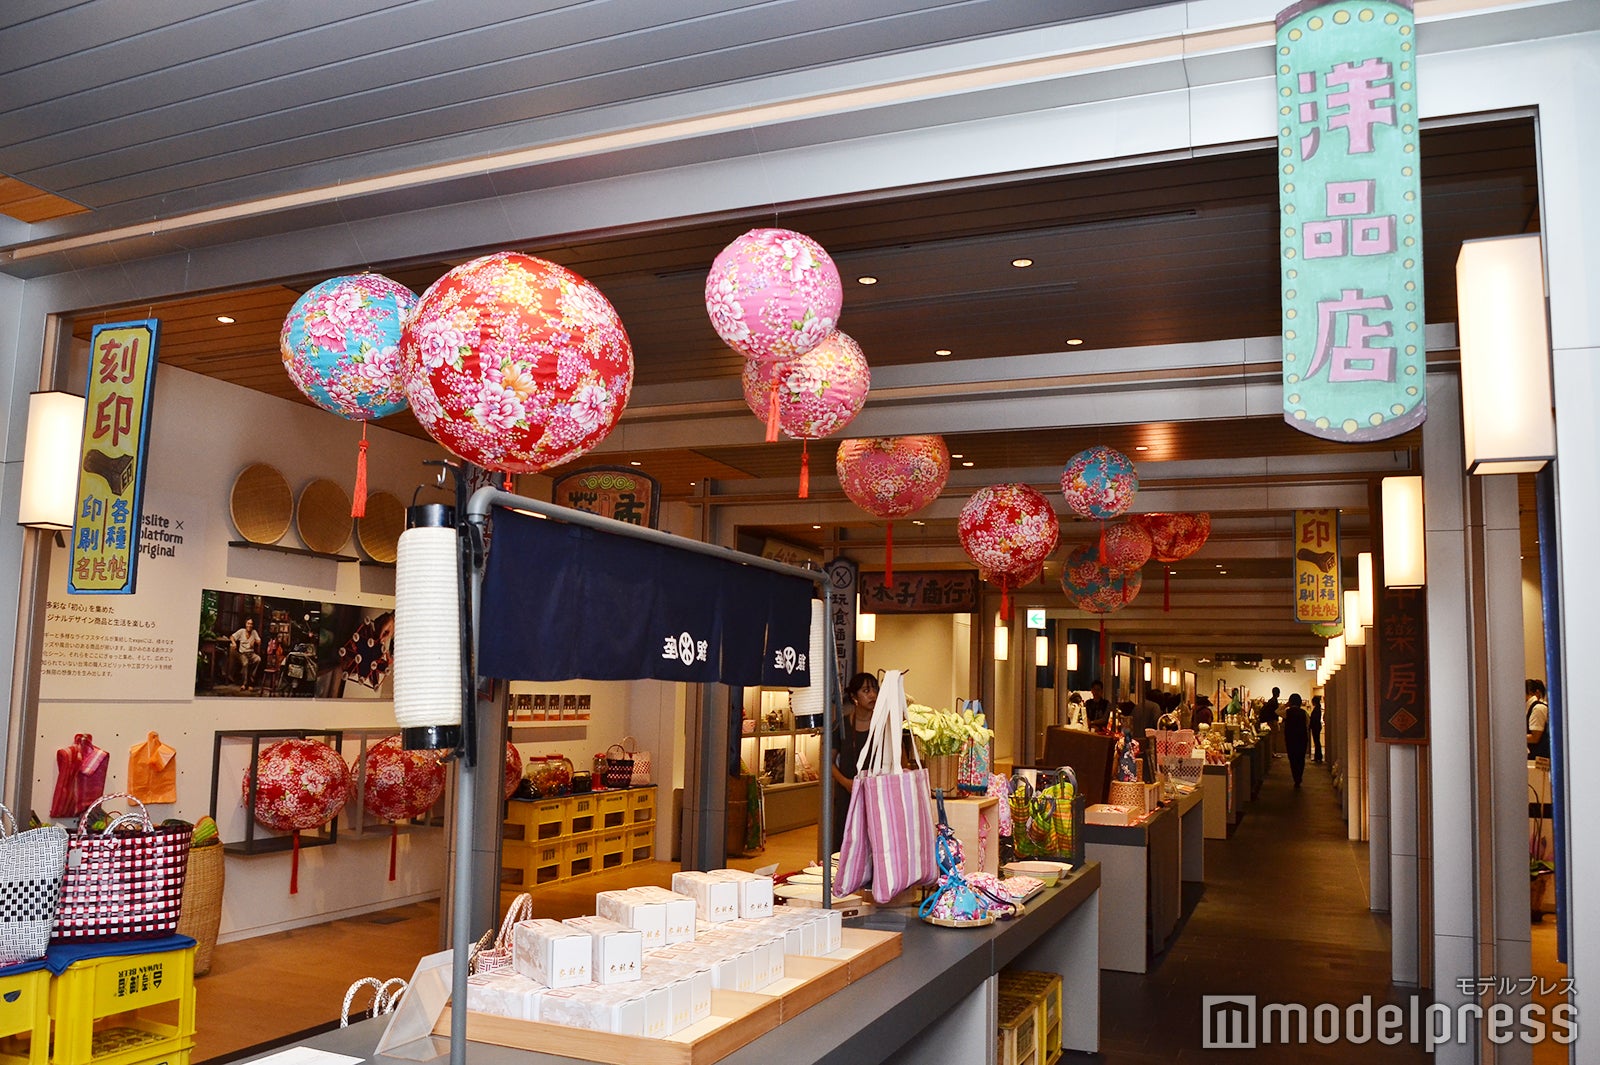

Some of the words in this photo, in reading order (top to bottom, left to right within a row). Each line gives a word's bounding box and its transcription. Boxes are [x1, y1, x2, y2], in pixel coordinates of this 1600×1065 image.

[1298, 57, 1397, 383] 洋品店
[92, 338, 138, 447] 刻印
[77, 494, 103, 552] 印刷
[105, 498, 129, 549] 各種
[1301, 509, 1331, 548] 印
[75, 554, 126, 581] 名片帖
